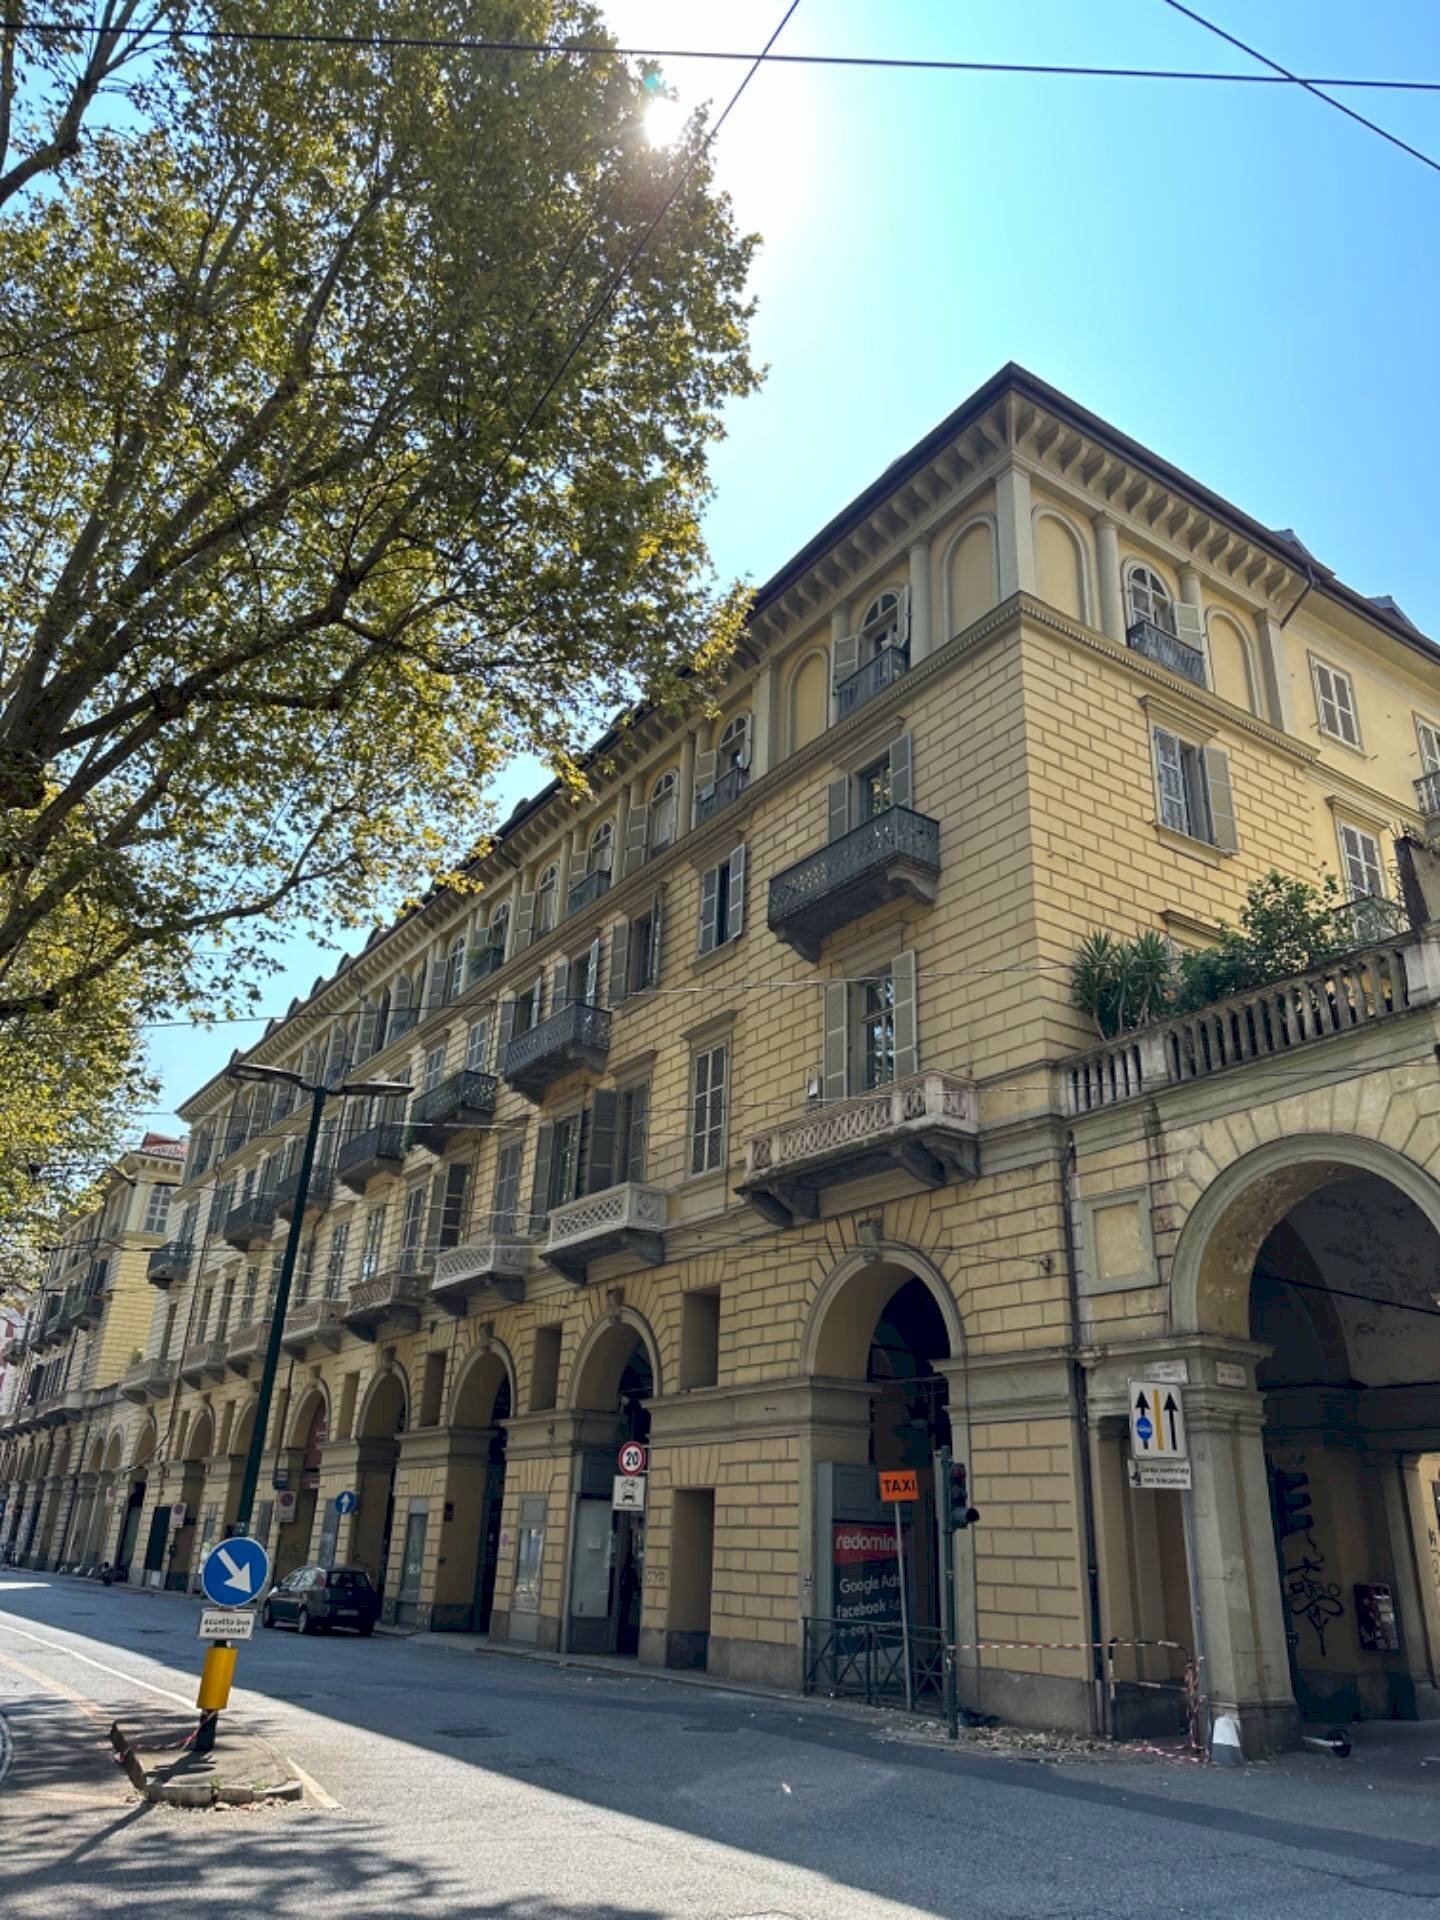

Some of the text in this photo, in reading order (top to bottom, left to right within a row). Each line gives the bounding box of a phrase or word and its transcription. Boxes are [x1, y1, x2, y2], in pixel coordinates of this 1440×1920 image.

[626, 1451, 639, 1466] 20
[883, 1479, 915, 1493] TAXI
[836, 1532, 902, 1552] redomin
[840, 1575, 880, 1595] Google
[836, 1598, 886, 1619] facebook
